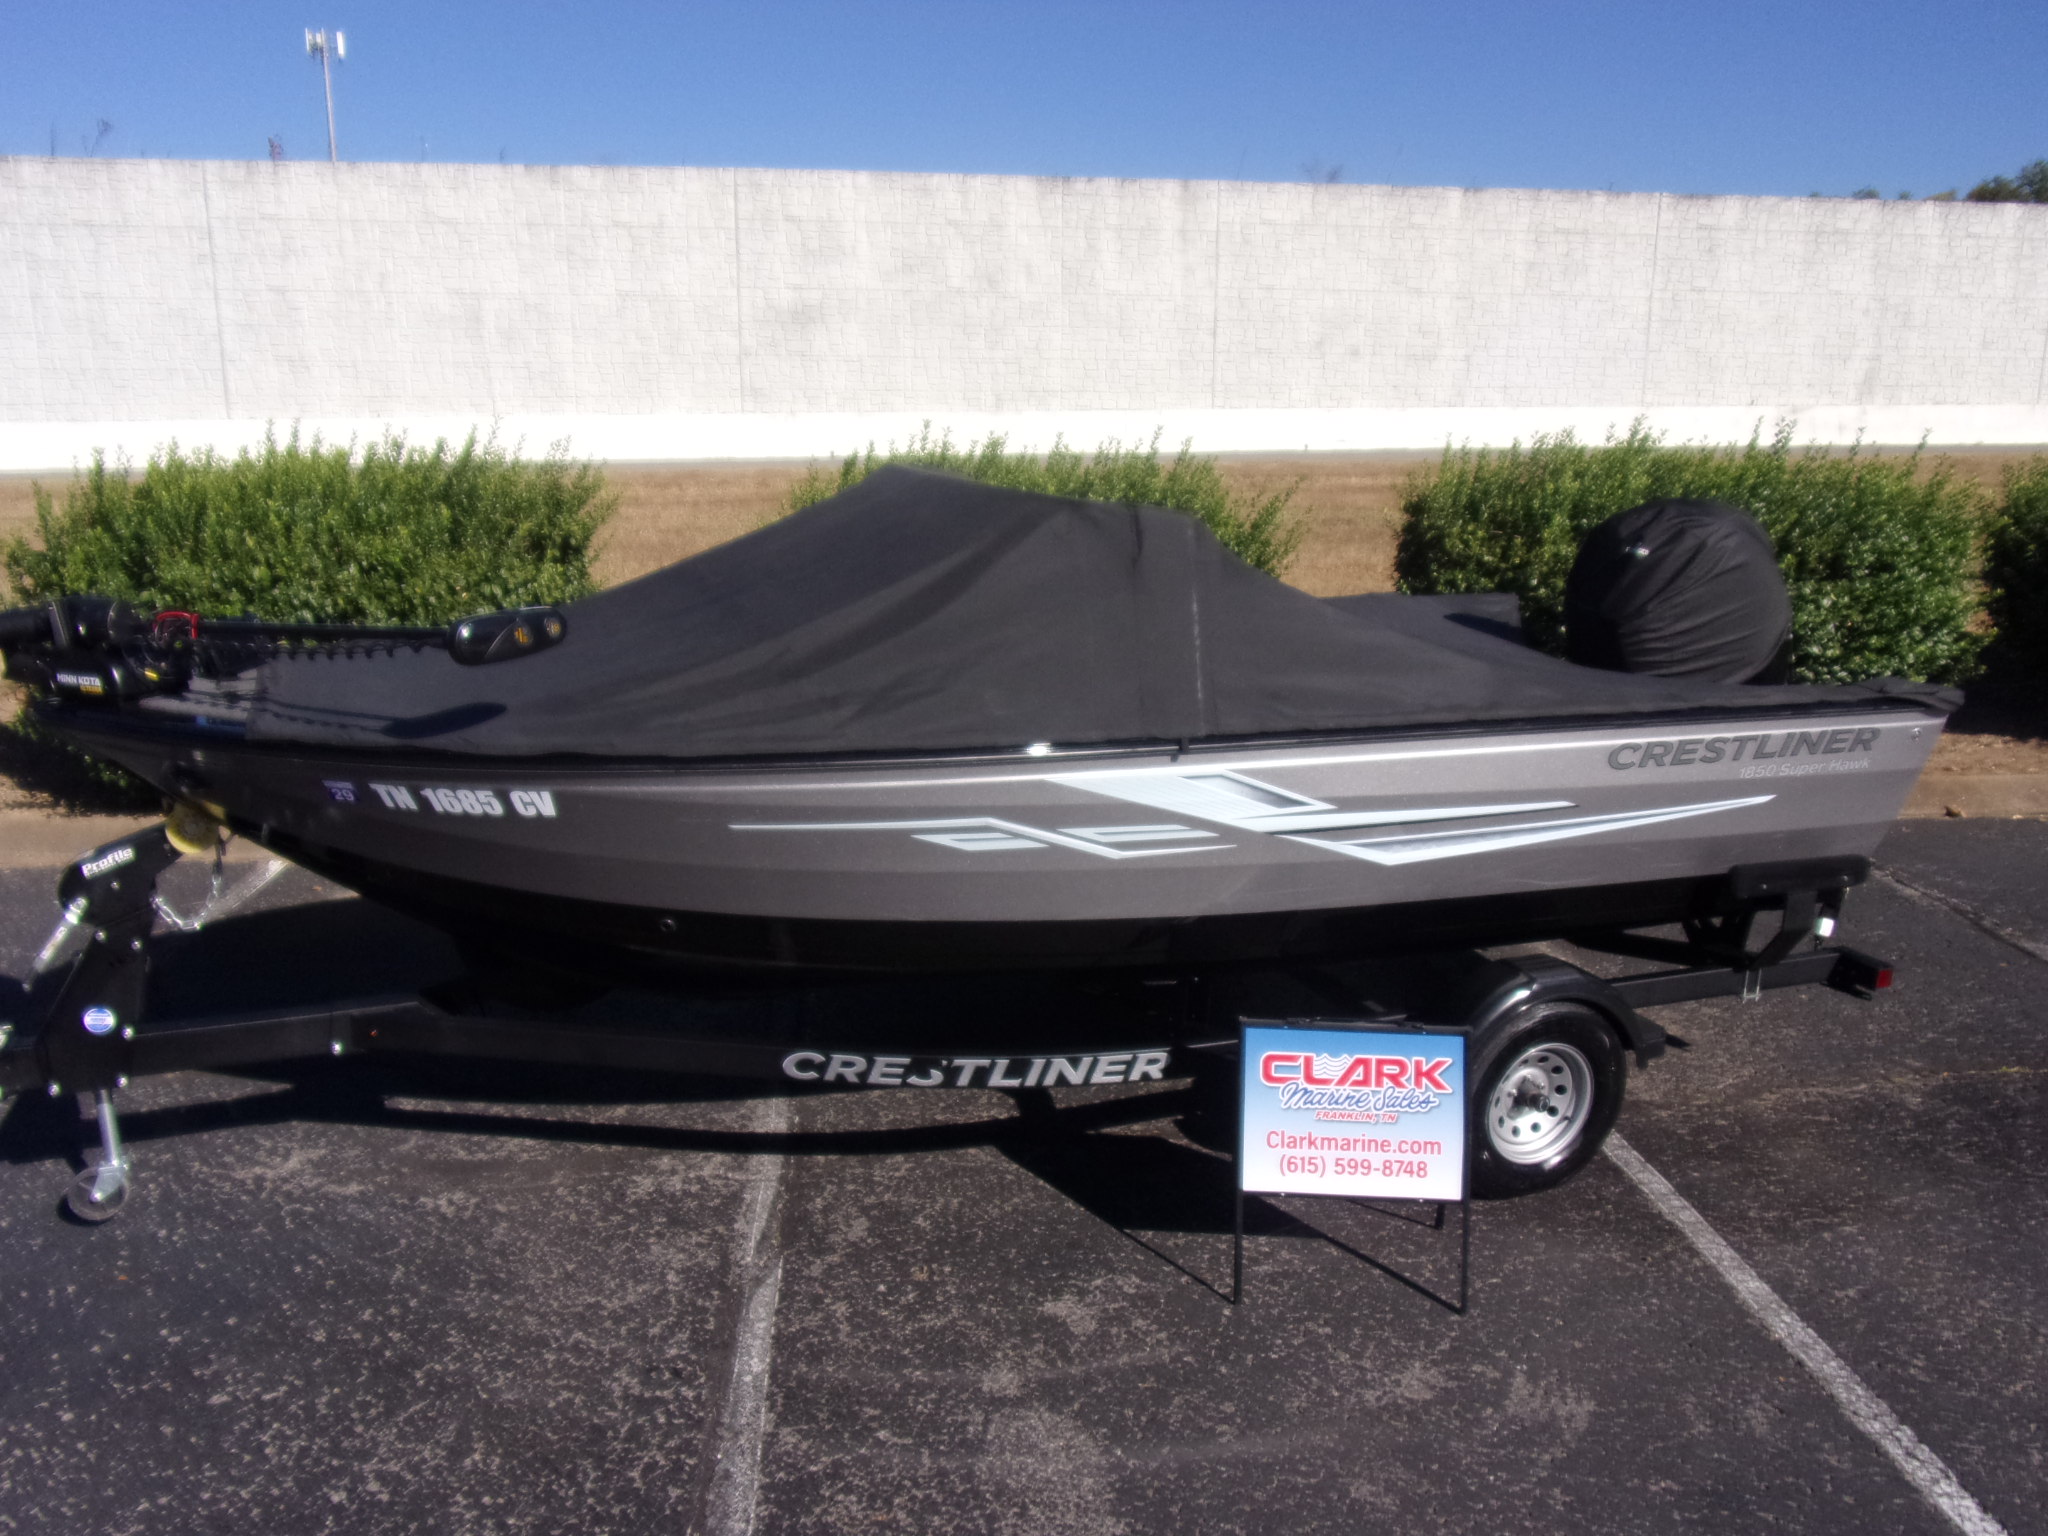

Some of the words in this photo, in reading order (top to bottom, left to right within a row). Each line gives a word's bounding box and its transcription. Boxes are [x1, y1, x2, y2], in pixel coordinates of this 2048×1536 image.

[78, 675, 101, 687] KOTA
[1607, 727, 1881, 770] CRESTLINER
[1739, 763, 1777, 779] 1850
[1778, 761, 1826, 777] Super
[1828, 757, 1872, 770] Hawk
[368, 783, 418, 810] TN
[420, 787, 503, 815] 1685
[509, 790, 556, 817] CV
[81, 847, 134, 877] Profile
[1261, 1052, 1452, 1092] CLARK
[1281, 1082, 1372, 1109] Marine
[1374, 1086, 1438, 1112] Sales
[1315, 1111, 1377, 1123] FRANKLIN,
[1380, 1113, 1397, 1123] TN
[1266, 1130, 1442, 1155] Clarkmarine.com
[1279, 1154, 1326, 1178] (615)
[1334, 1158, 1428, 1179] 599-8748
